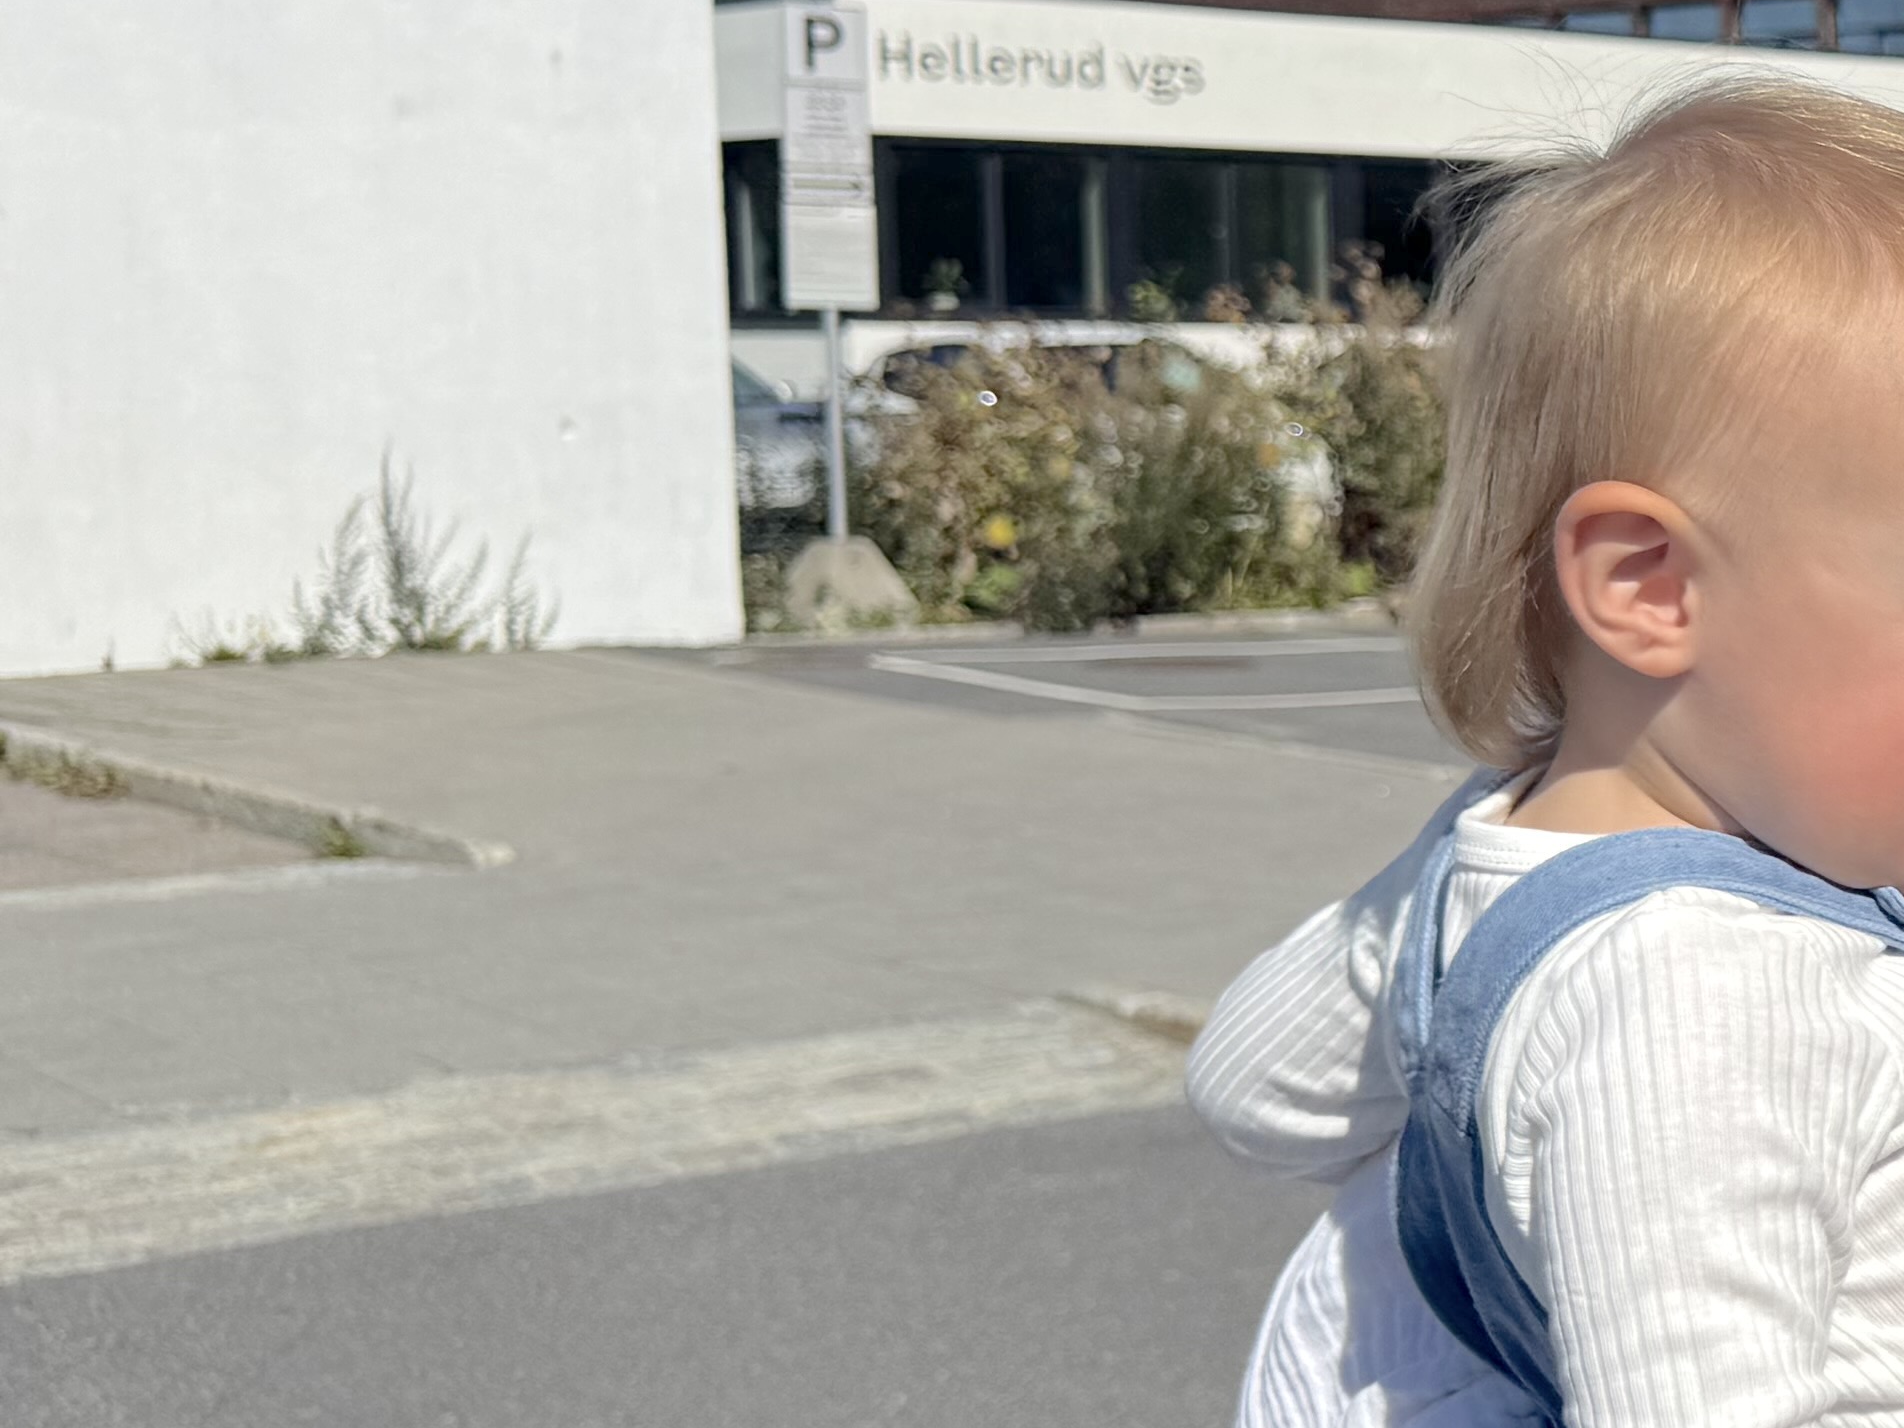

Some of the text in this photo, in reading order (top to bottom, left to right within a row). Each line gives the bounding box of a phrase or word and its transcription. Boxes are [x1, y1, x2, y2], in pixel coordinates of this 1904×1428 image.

[804, 15, 842, 70] P
[878, 29, 1206, 105] Hellerud vgs
